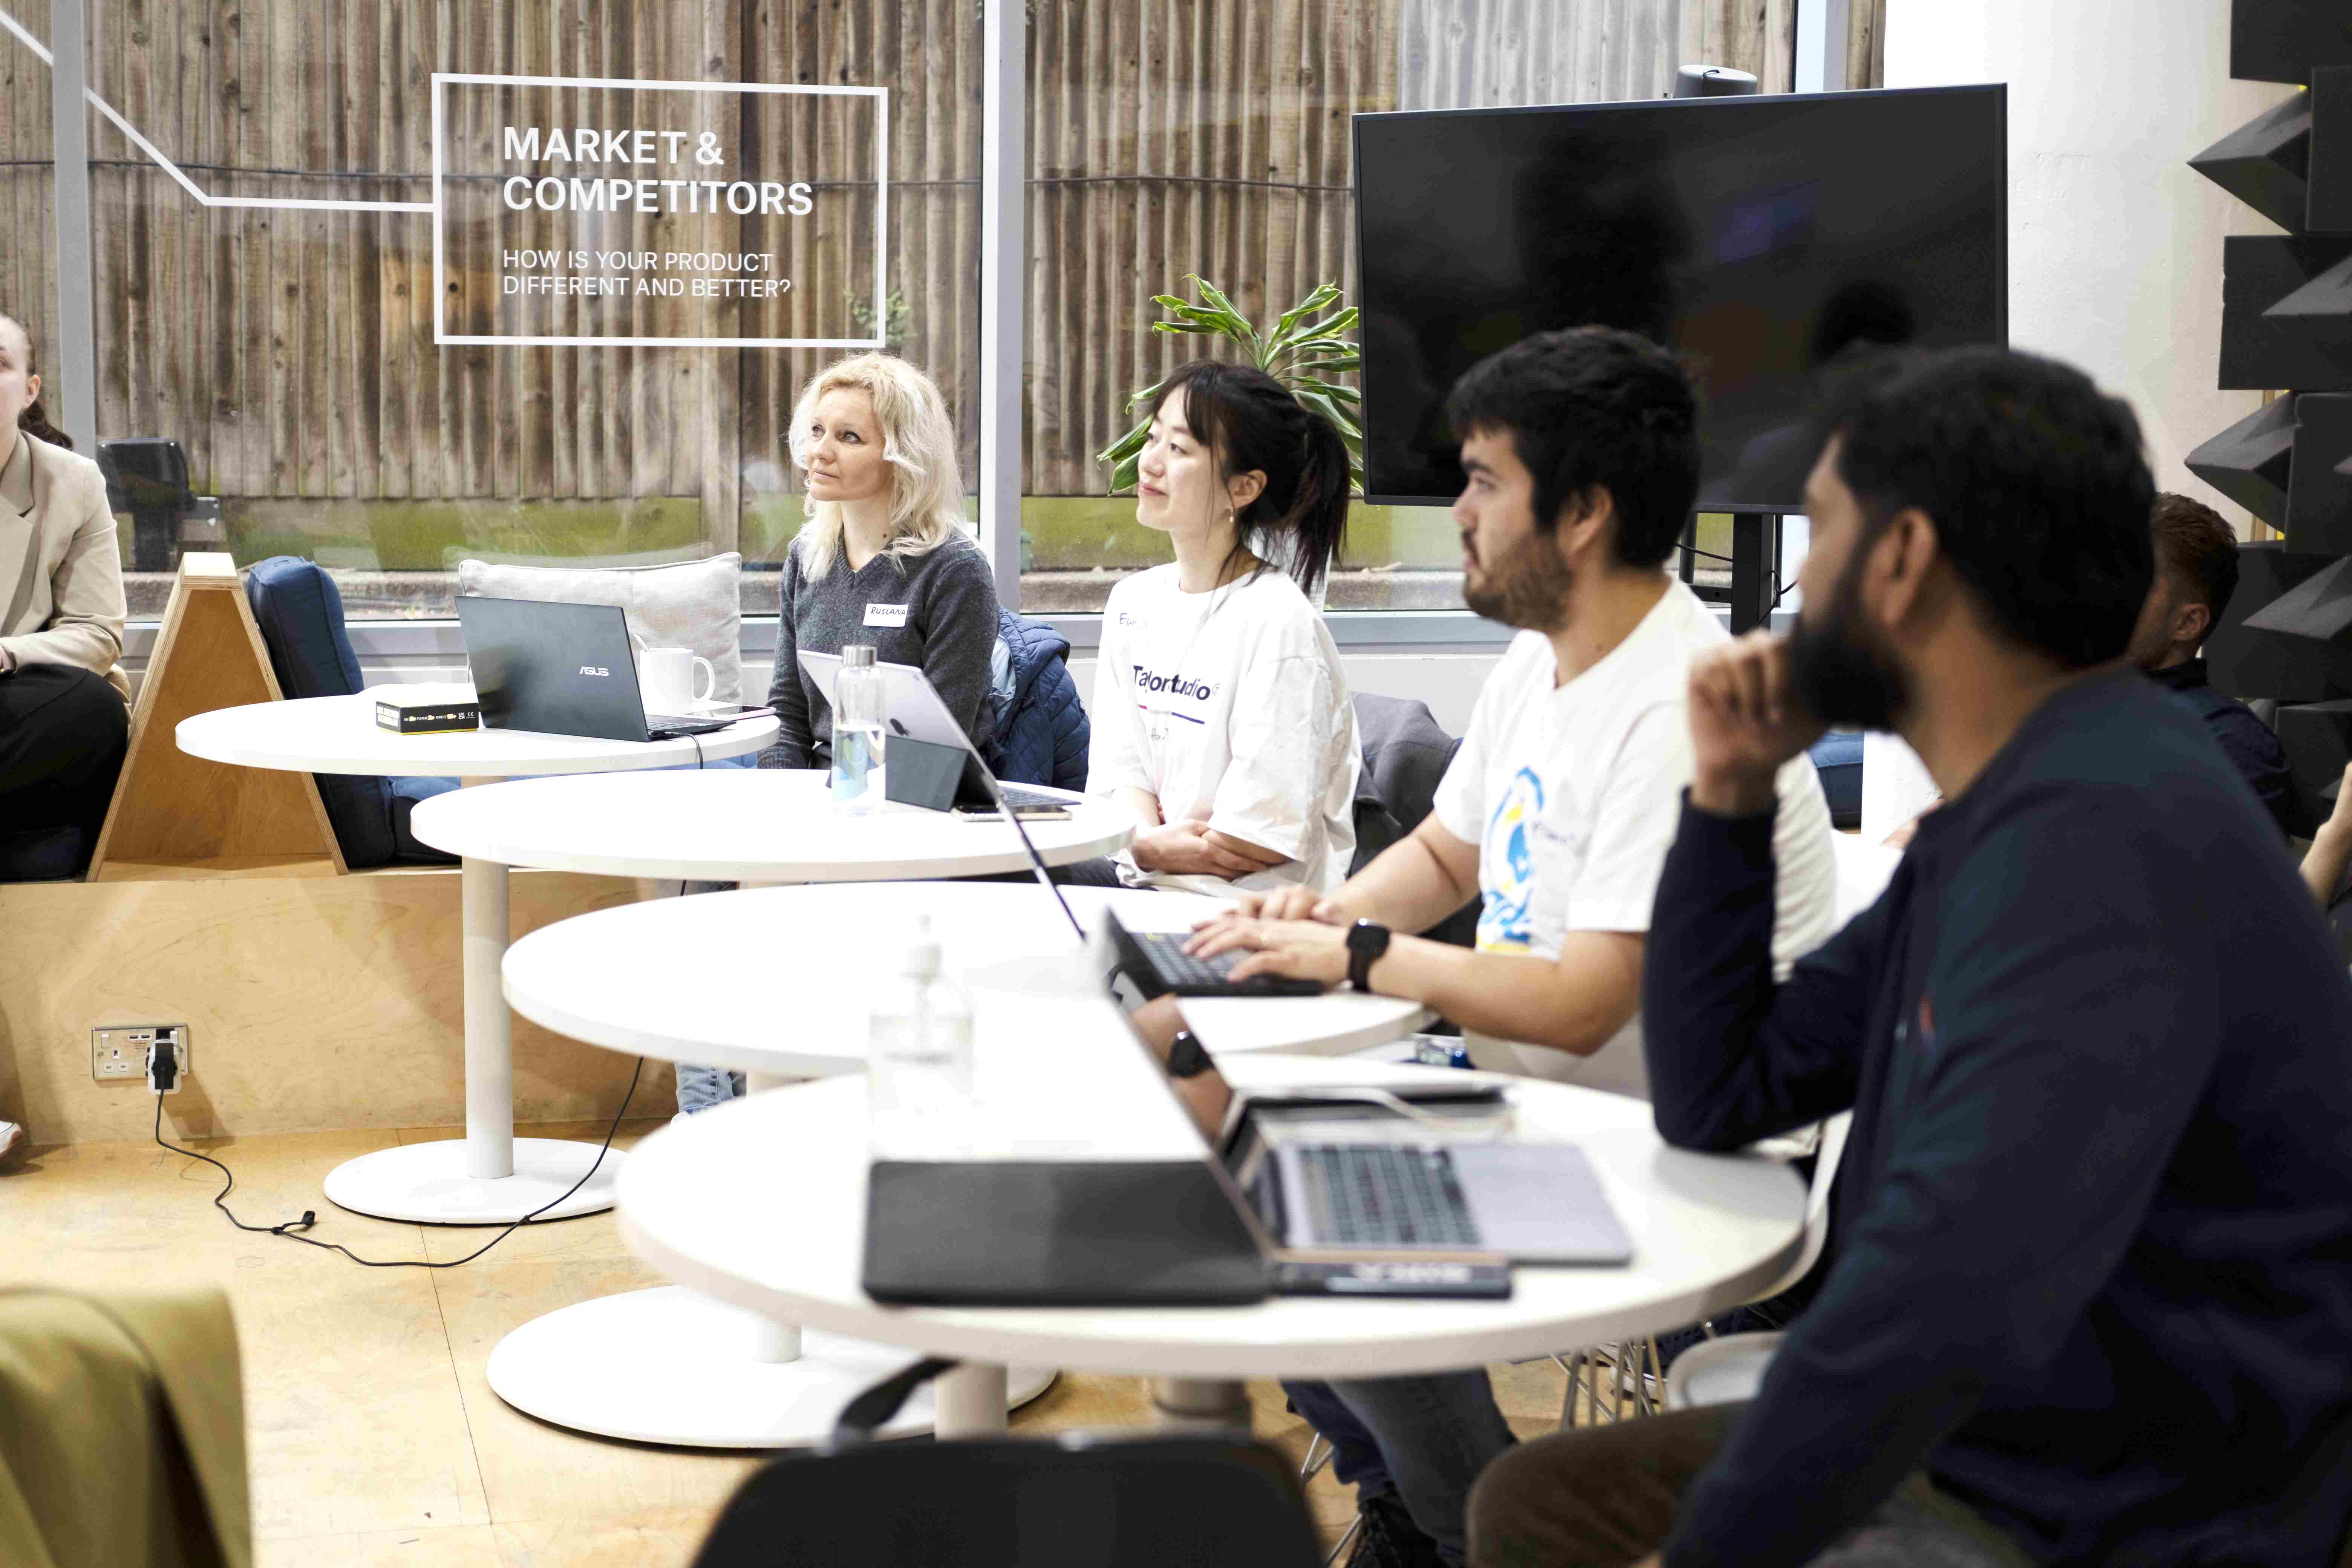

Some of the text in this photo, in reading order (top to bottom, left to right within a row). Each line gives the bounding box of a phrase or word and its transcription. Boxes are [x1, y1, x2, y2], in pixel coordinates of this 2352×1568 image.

[504, 127, 724, 165] MARKET &
[504, 176, 813, 215] COMPETITORS
[504, 250, 774, 271] HOW IS YOUR PRODUCT
[504, 276, 791, 297] DIFFERENT AND BETTER?
[871, 607, 905, 615] RUSLANA
[579, 666, 609, 676] ASUS
